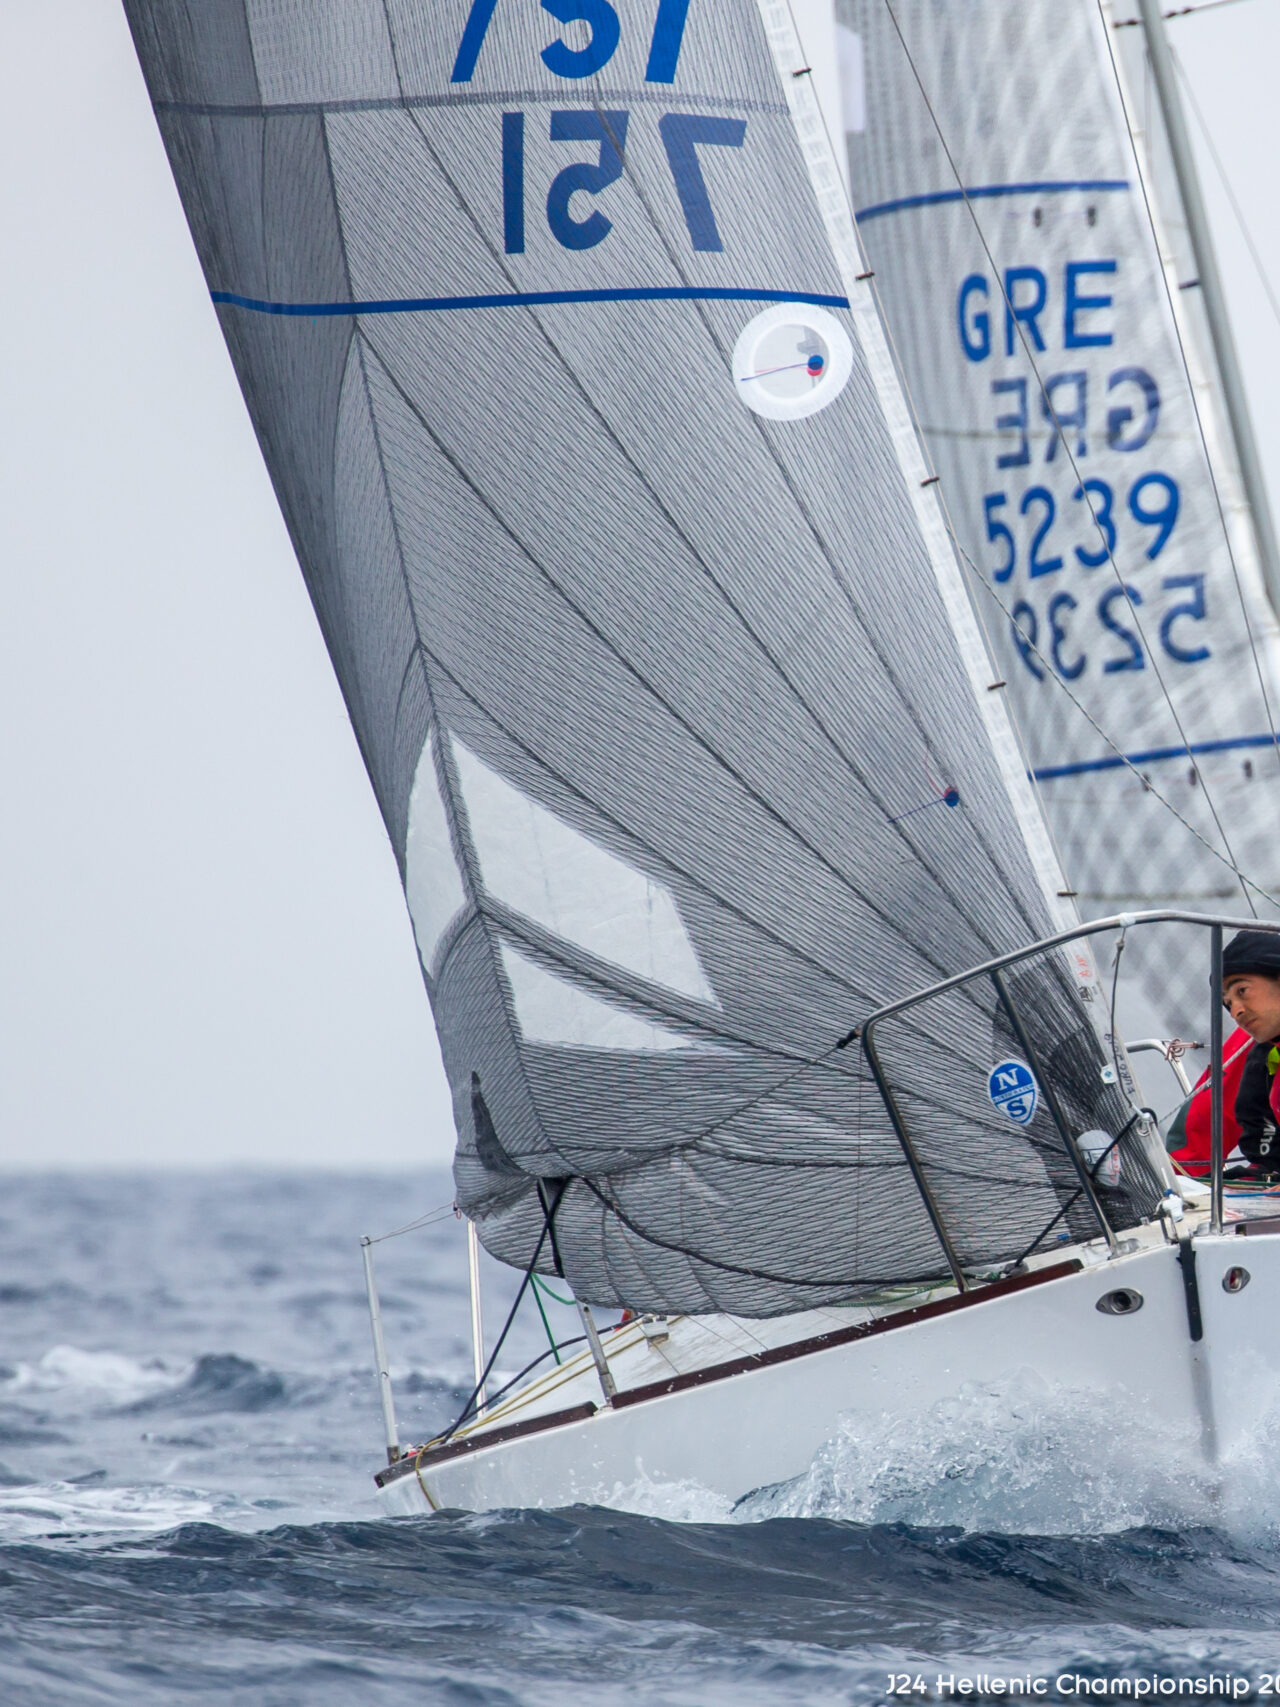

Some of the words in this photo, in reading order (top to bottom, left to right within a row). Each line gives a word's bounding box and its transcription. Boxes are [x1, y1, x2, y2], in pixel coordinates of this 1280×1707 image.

[956, 258, 1119, 364] GRE
[982, 471, 1182, 584] 5239
[995, 1067, 1019, 1091] N
[1006, 1098, 1027, 1118] S
